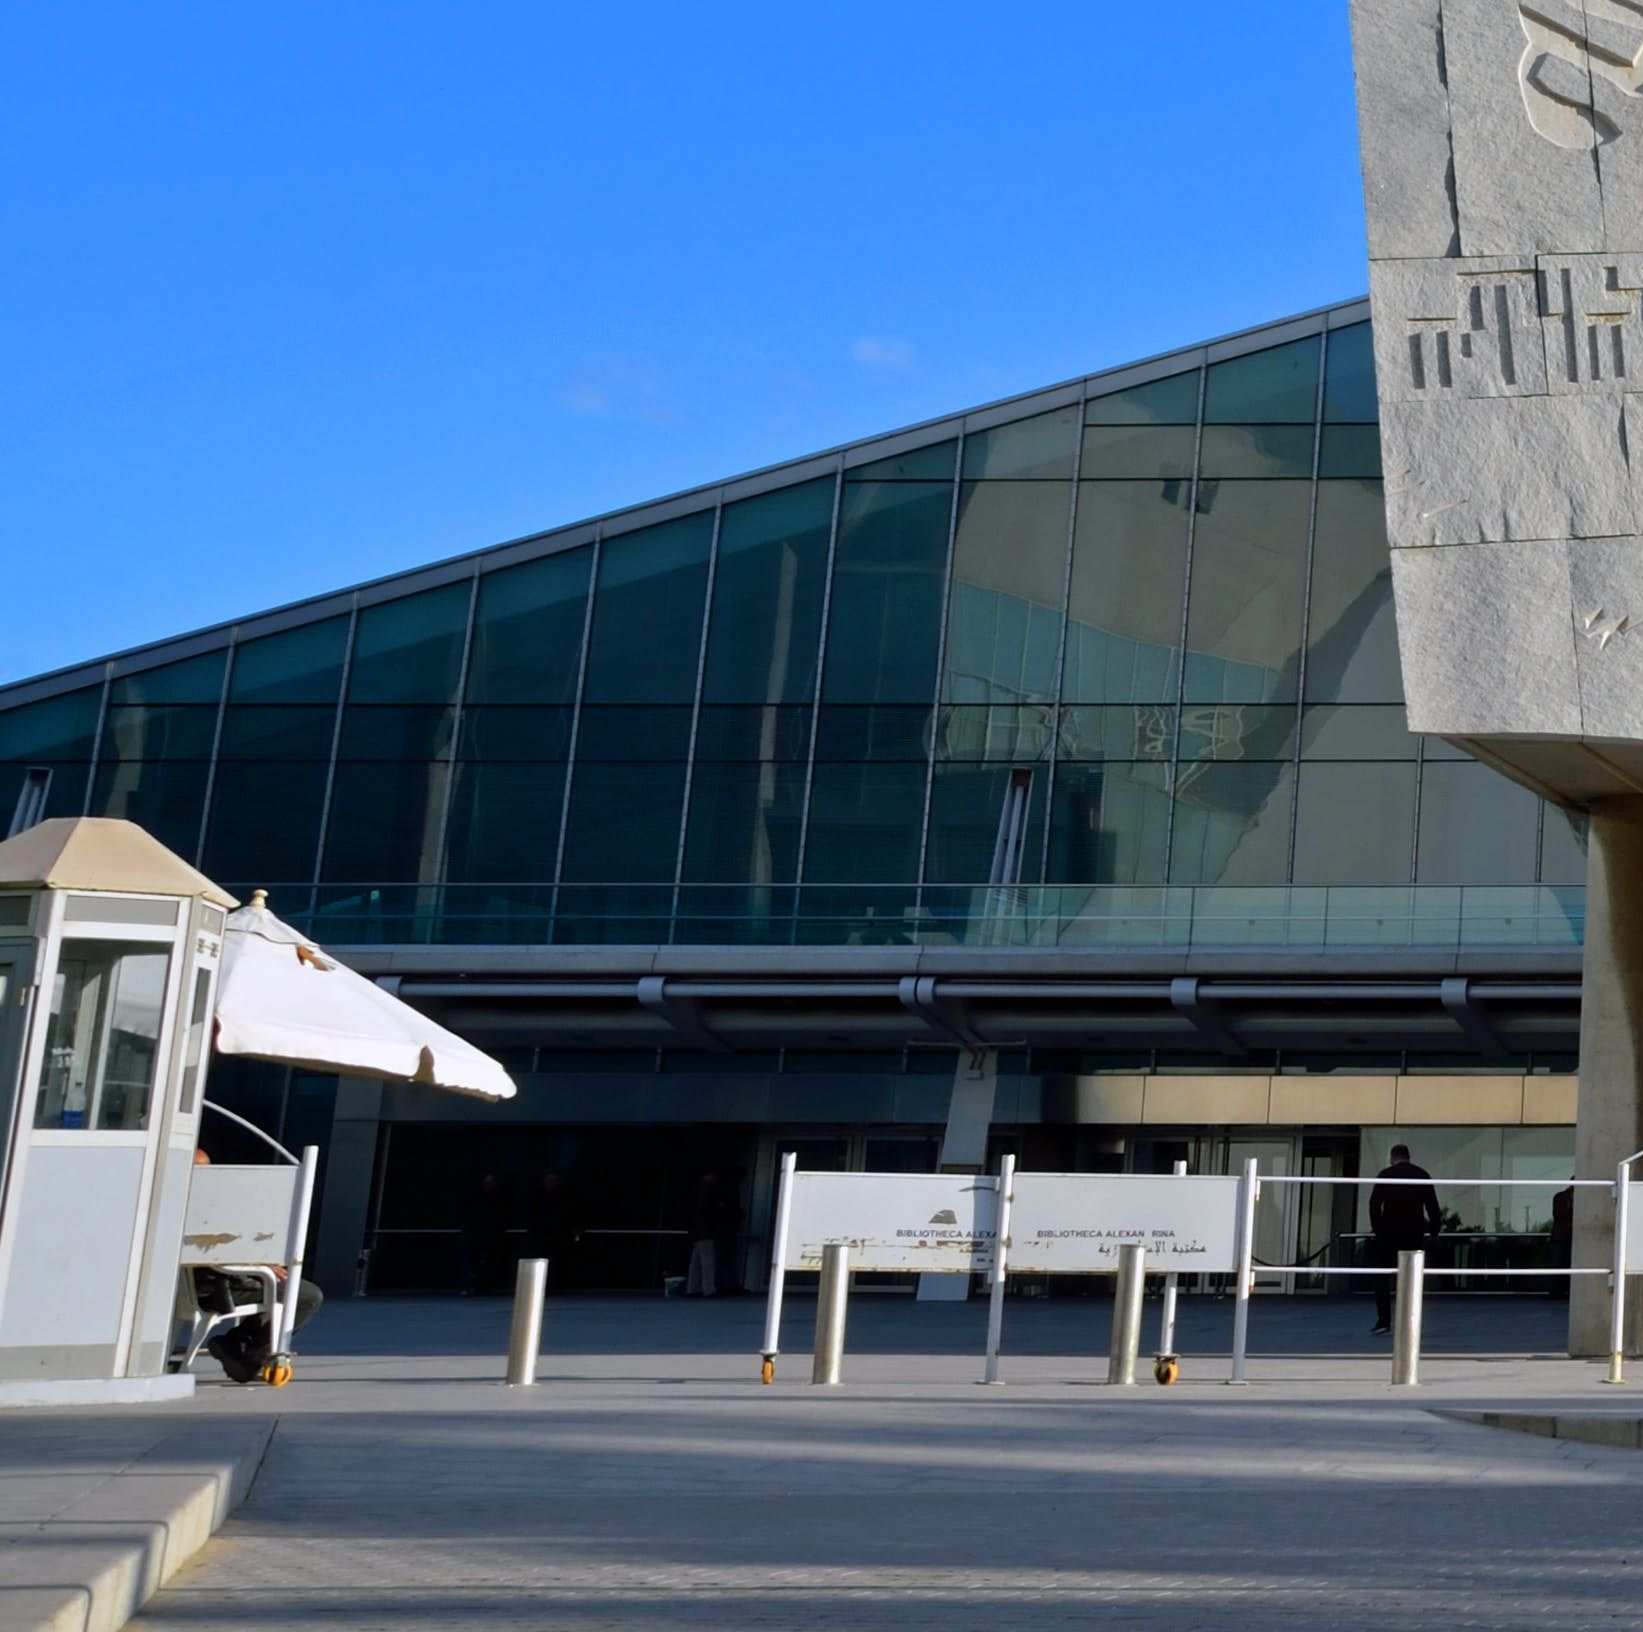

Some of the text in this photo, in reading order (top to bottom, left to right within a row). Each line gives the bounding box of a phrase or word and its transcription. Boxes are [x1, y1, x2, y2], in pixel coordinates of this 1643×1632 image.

[896, 1229, 963, 1238] BIBLIOTHECA
[1036, 1229, 1176, 1239] BIBLIOTHECA ALEXANRINA
[1171, 1240, 1207, 1257] مكتبة
